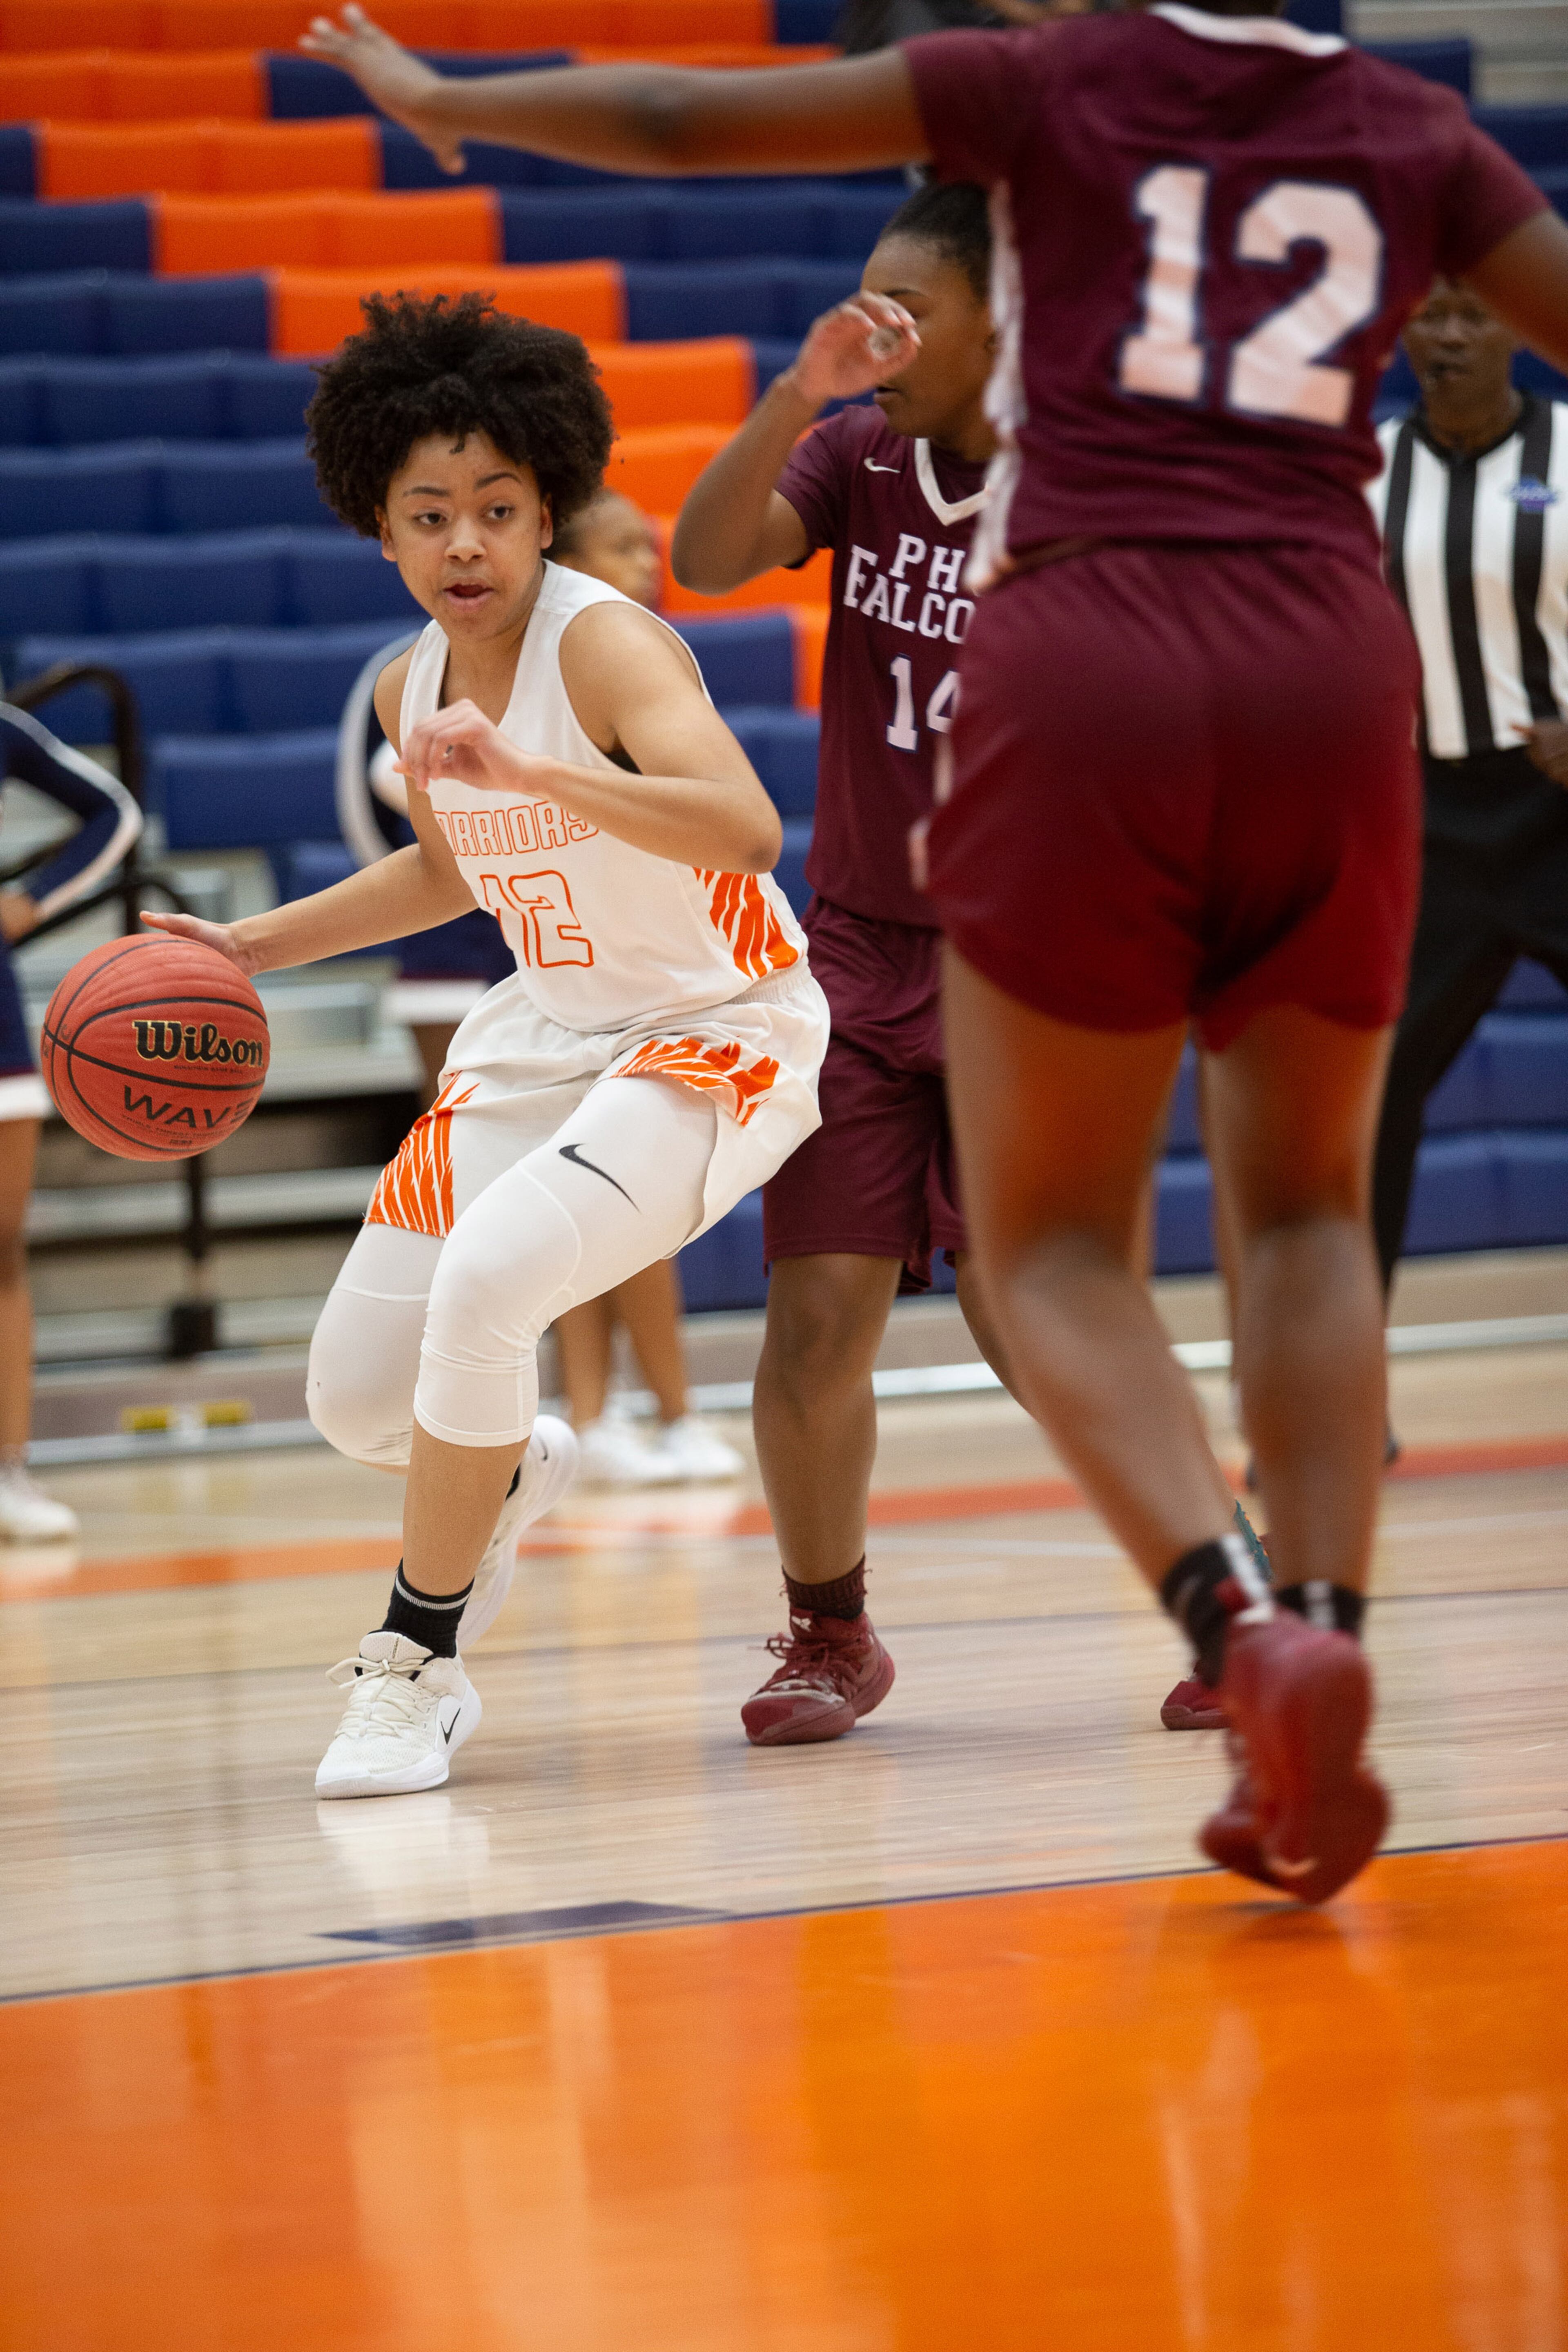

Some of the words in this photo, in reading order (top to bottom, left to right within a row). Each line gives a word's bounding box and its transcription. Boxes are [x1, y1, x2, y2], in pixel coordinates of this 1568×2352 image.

[1117, 163, 1383, 429] 12
[843, 544, 977, 644] FALCO
[888, 533, 966, 593] PH
[886, 654, 962, 752] 14
[479, 869, 594, 969] 12
[131, 1020, 264, 1068] Wilson
[124, 1085, 254, 1128] WAVE
